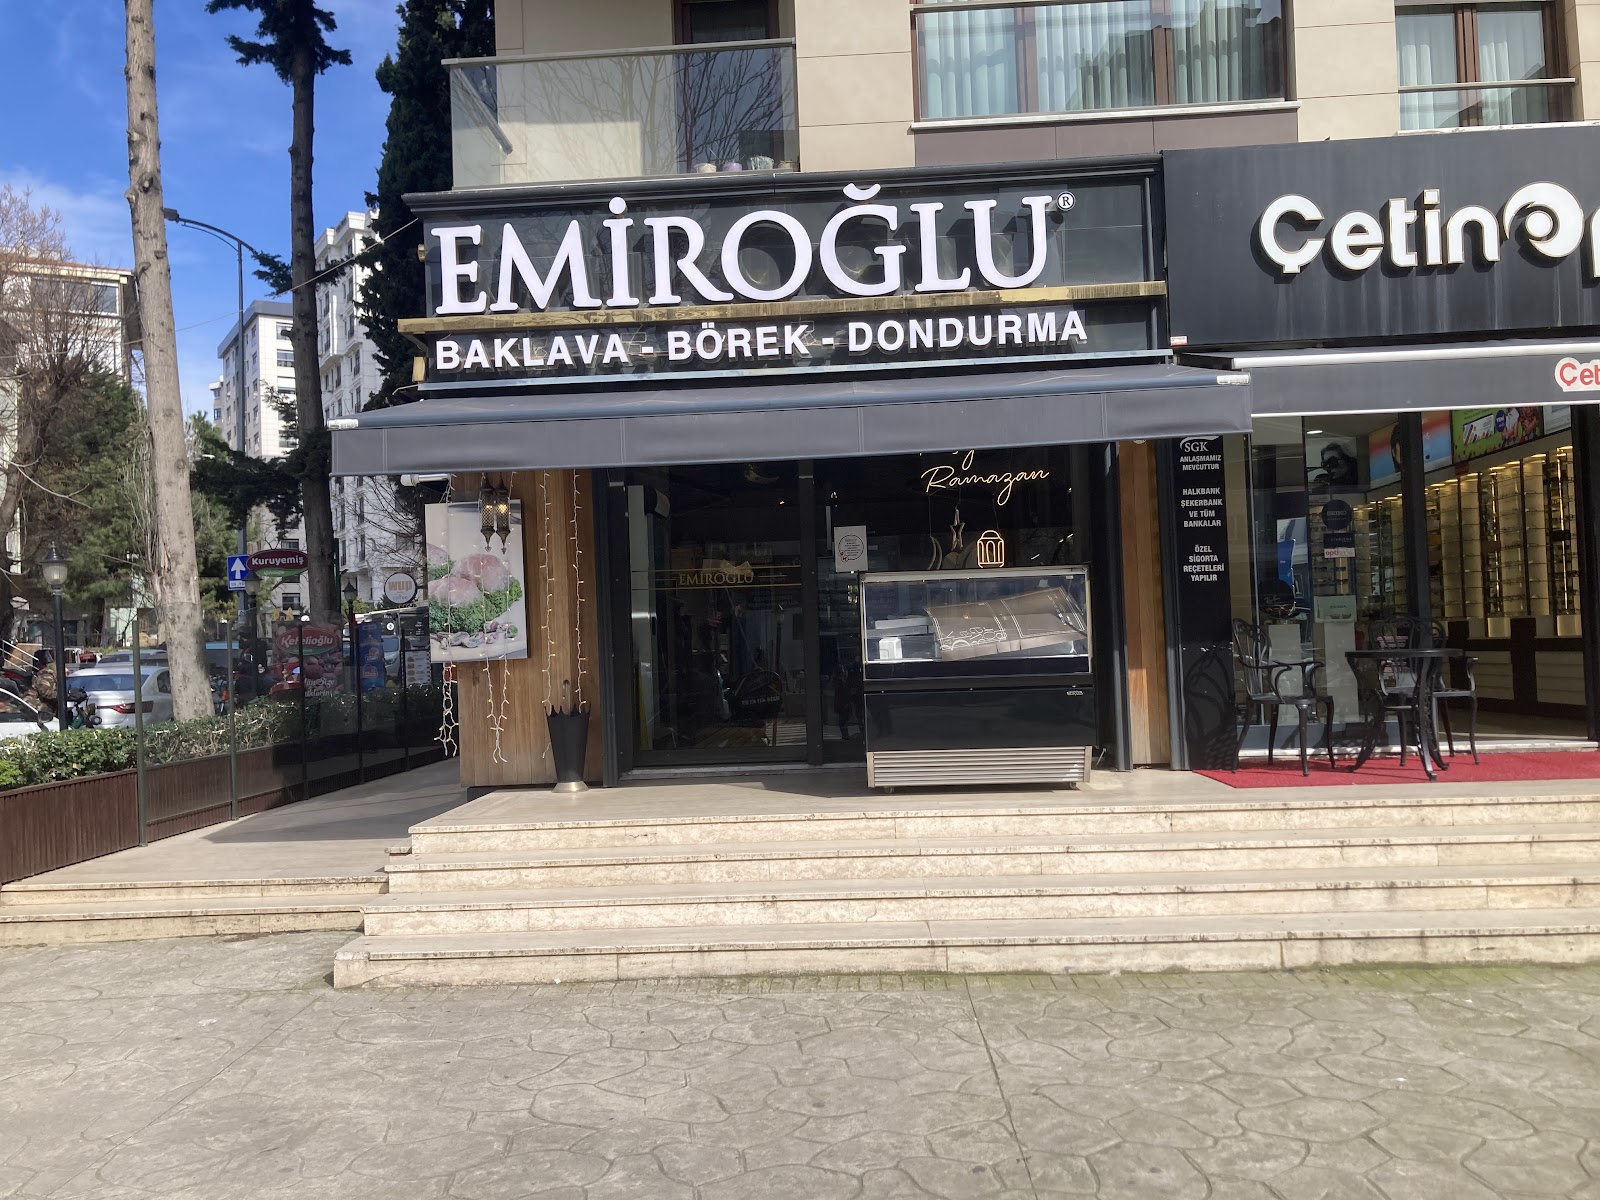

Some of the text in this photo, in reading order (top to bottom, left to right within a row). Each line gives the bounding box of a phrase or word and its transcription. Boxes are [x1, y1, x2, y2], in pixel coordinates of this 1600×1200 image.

[430, 182, 1053, 315] EMİROĞLU
[435, 333, 630, 370] BAKLAVA
[667, 322, 810, 361] BÖREK
[848, 310, 1088, 352] DONDURMA
[1184, 441, 1209, 453] SGK
[1179, 454, 1222, 463] ANLAŞMAMIZ
[1182, 463, 1220, 471] MEVCUTTUR
[920, 465, 1050, 506] Ramazan
[1182, 487, 1221, 496] HALKBANK
[1180, 498, 1223, 509] ŞEKERBANK
[1188, 508, 1216, 518] VE TÜM
[1183, 519, 1222, 528] BANKALAR
[1194, 544, 1213, 553] ÖZEL
[251, 555, 305, 566] Kuruyemiş
[1188, 553, 1219, 563] SİGORTA
[1183, 562, 1225, 574] REÇETELERİ
[1190, 573, 1218, 582] YAPILIR
